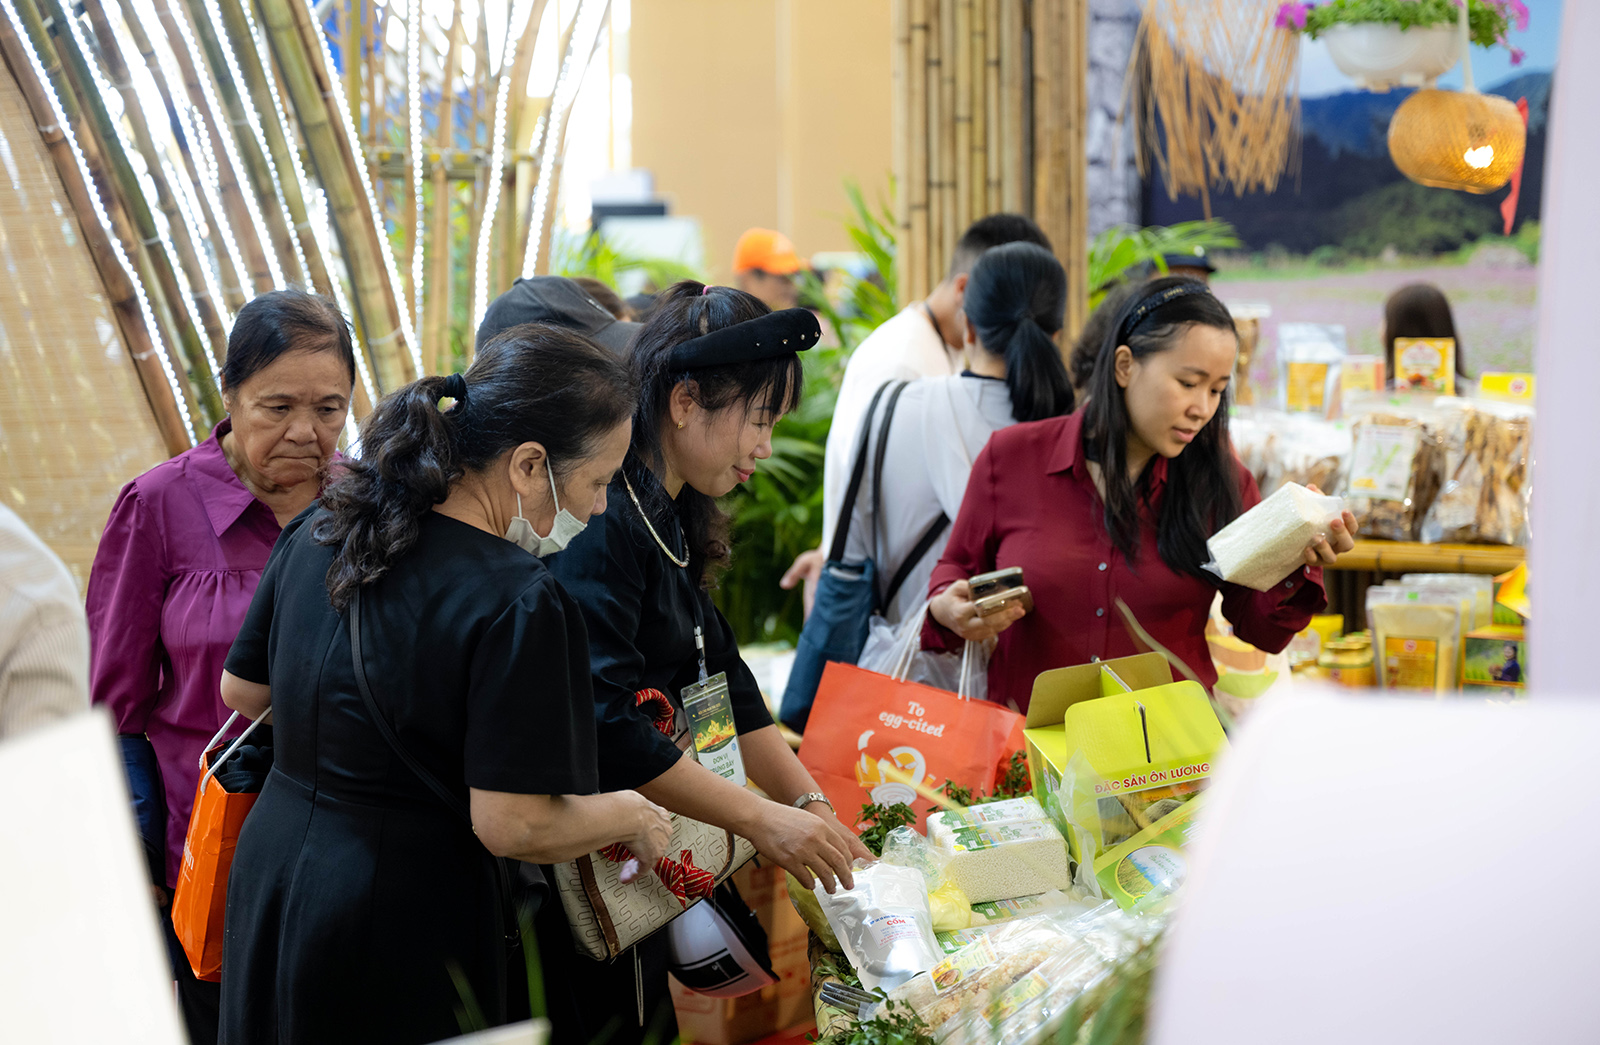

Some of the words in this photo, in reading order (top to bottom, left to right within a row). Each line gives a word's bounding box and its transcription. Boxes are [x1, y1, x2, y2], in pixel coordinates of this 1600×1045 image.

[907, 701, 926, 717] To
[879, 711, 945, 738] egg-cited
[1094, 780, 1121, 795] ĐẶC
[1123, 774, 1147, 789] SẢN
[1149, 770, 1168, 784] ÔN
[1170, 763, 1210, 779] LƯƠNG
